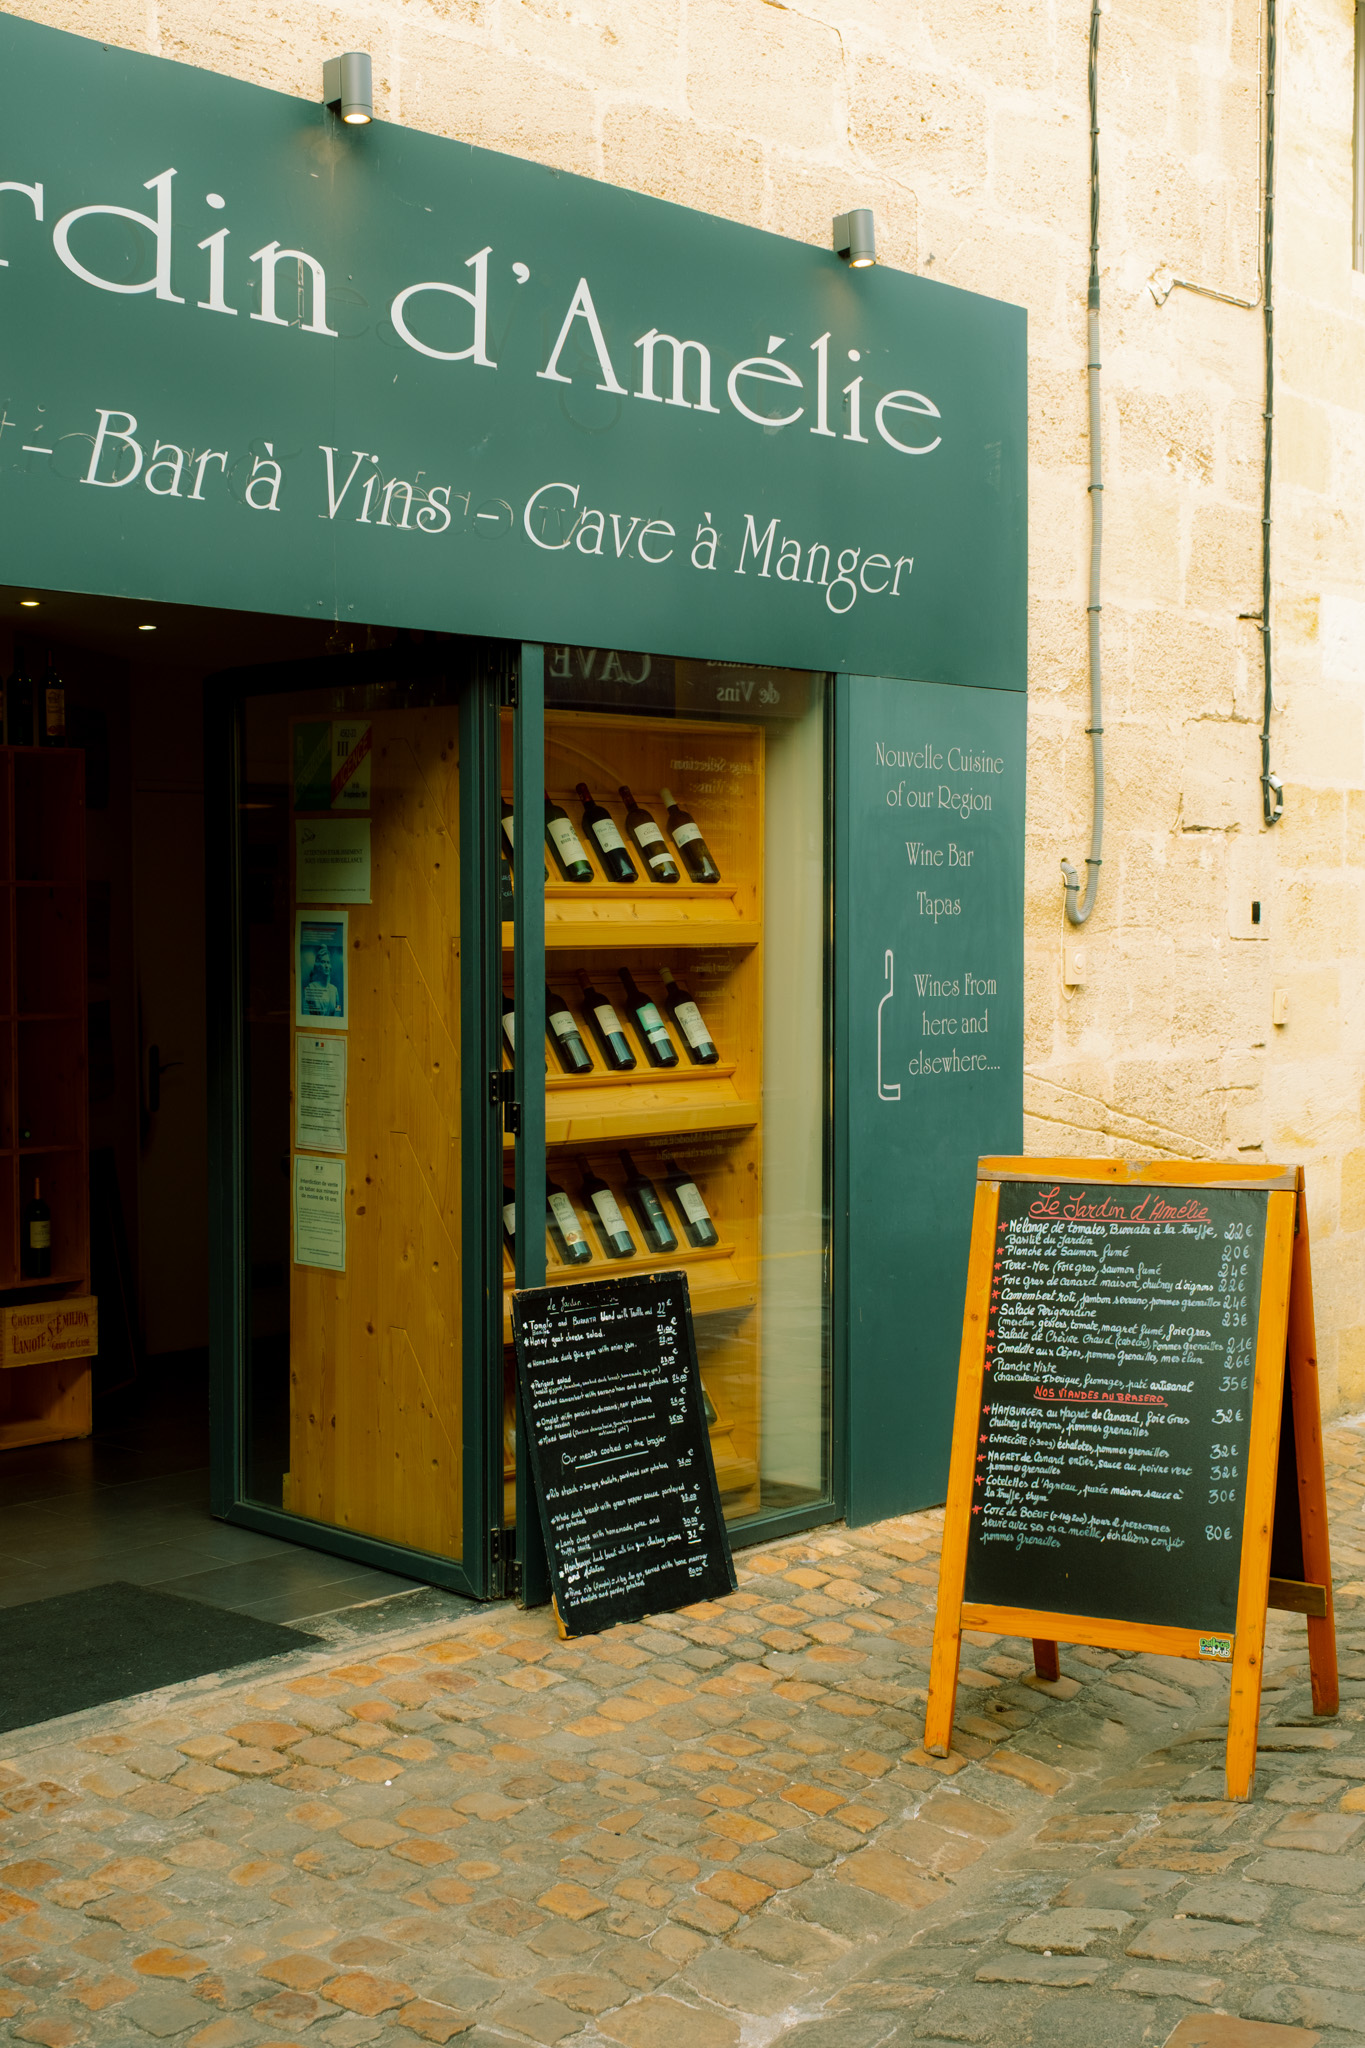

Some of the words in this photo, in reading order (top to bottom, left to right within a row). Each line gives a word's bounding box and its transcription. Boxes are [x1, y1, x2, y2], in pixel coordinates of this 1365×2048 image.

[390, 246, 944, 456] d'Amélie
[80, 408, 228, 501] Bar
[244, 442, 282, 512] à
[319, 446, 454, 534] Vins
[523, 482, 676, 564] Cave
[691, 511, 719, 572] à
[734, 514, 914, 614] Manger
[875, 742, 944, 770] Nouvelle
[947, 747, 1004, 774] Cuisine
[886, 780, 906, 807] of
[906, 791, 933, 808] our
[937, 785, 992, 820] Region
[905, 842, 944, 867] Wine
[948, 843, 974, 867] Bar
[916, 890, 962, 924] Tapas
[913, 974, 960, 997] Wines
[964, 972, 997, 996] From
[922, 1010, 958, 1036] here
[961, 1008, 988, 1033] and
[1030, 1187, 1060, 1215] Le
[1063, 1191, 1127, 1219] Jardin
[1050, 1220, 1065, 1234] de
[1153, 1223, 1162, 1234] à
[1162, 1223, 1176, 1234] la
[1043, 1233, 1056, 1245] du
[1005, 1244, 1042, 1256] Planche
[1044, 1245, 1057, 1256] de
[1001, 1273, 1020, 1286] Foie
[1046, 1275, 1059, 1286] de
[1135, 1261, 1162, 1280] fumé
[1001, 1287, 1057, 1301] Camembert
[999, 1302, 1036, 1316] Salade
[997, 1326, 1028, 1340] Salade
[1031, 1330, 1043, 1342] de
[1035, 1348, 1054, 1357] aux
[1058, 1388, 1099, 1400] VIANDES
[1101, 1392, 1114, 1400] AU
[1116, 1393, 1164, 1403] BRASERO
[991, 1402, 1043, 1419] HAMBURGER
[1046, 1409, 1058, 1417] au
[1091, 1408, 1102, 1420] de
[561, 1452, 577, 1465] Our
[579, 1448, 598, 1461] meats
[600, 1442, 622, 1456] cooked
[987, 1450, 1021, 1462] MAGRET
[1020, 1452, 1033, 1463] de
[1124, 1462, 1136, 1471] au
[1025, 1491, 1049, 1505] thym
[1110, 1485, 1143, 1498] maison
[1006, 1506, 1018, 1517] de
[1120, 1519, 1170, 1533] personnes
